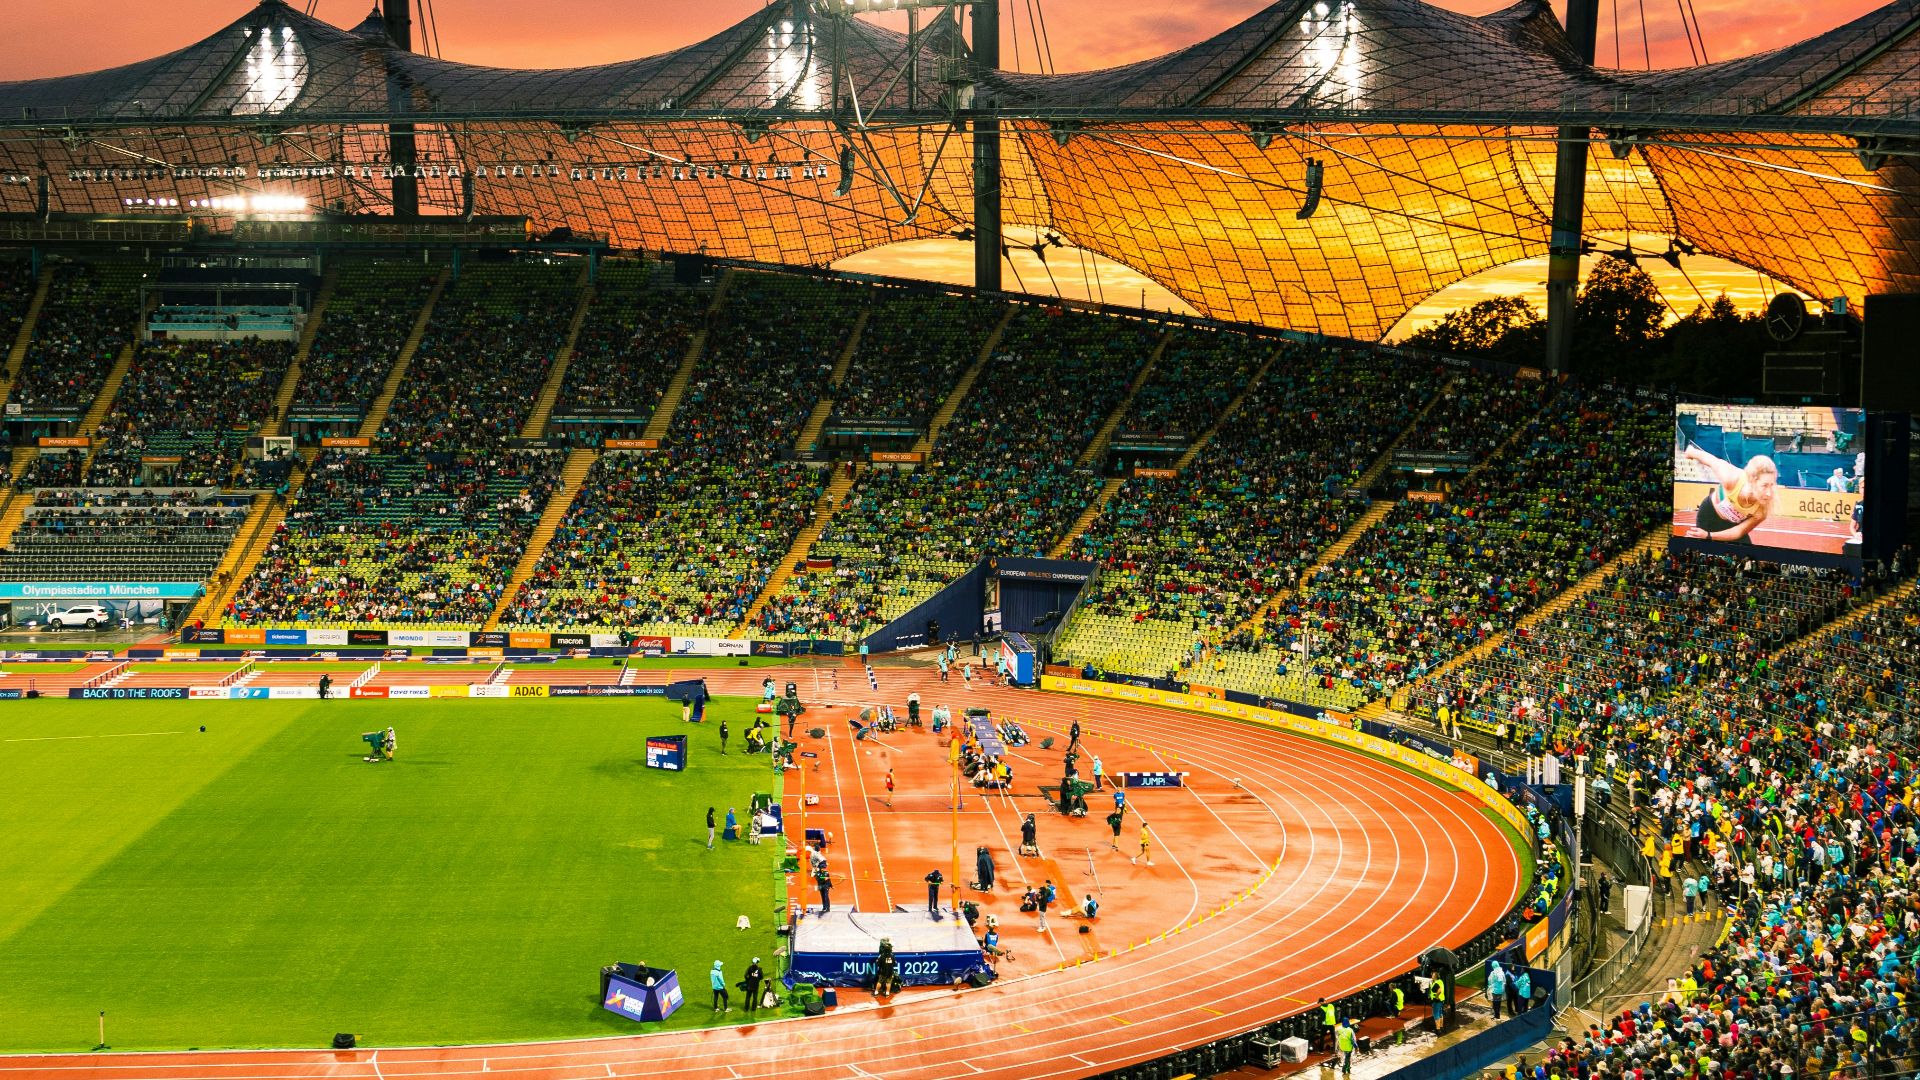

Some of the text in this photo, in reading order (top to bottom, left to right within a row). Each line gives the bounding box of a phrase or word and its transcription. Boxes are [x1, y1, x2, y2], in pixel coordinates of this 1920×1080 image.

[1800, 498, 1852, 515] adac.de
[22, 584, 160, 596] Olympiastadion München
[84, 688, 182, 698] BACK TO THE ROOFS
[514, 687, 542, 696] ADAC
[1141, 778, 1166, 786] JUMP!
[843, 962, 900, 975] MUNH
[904, 961, 938, 974] 2022
